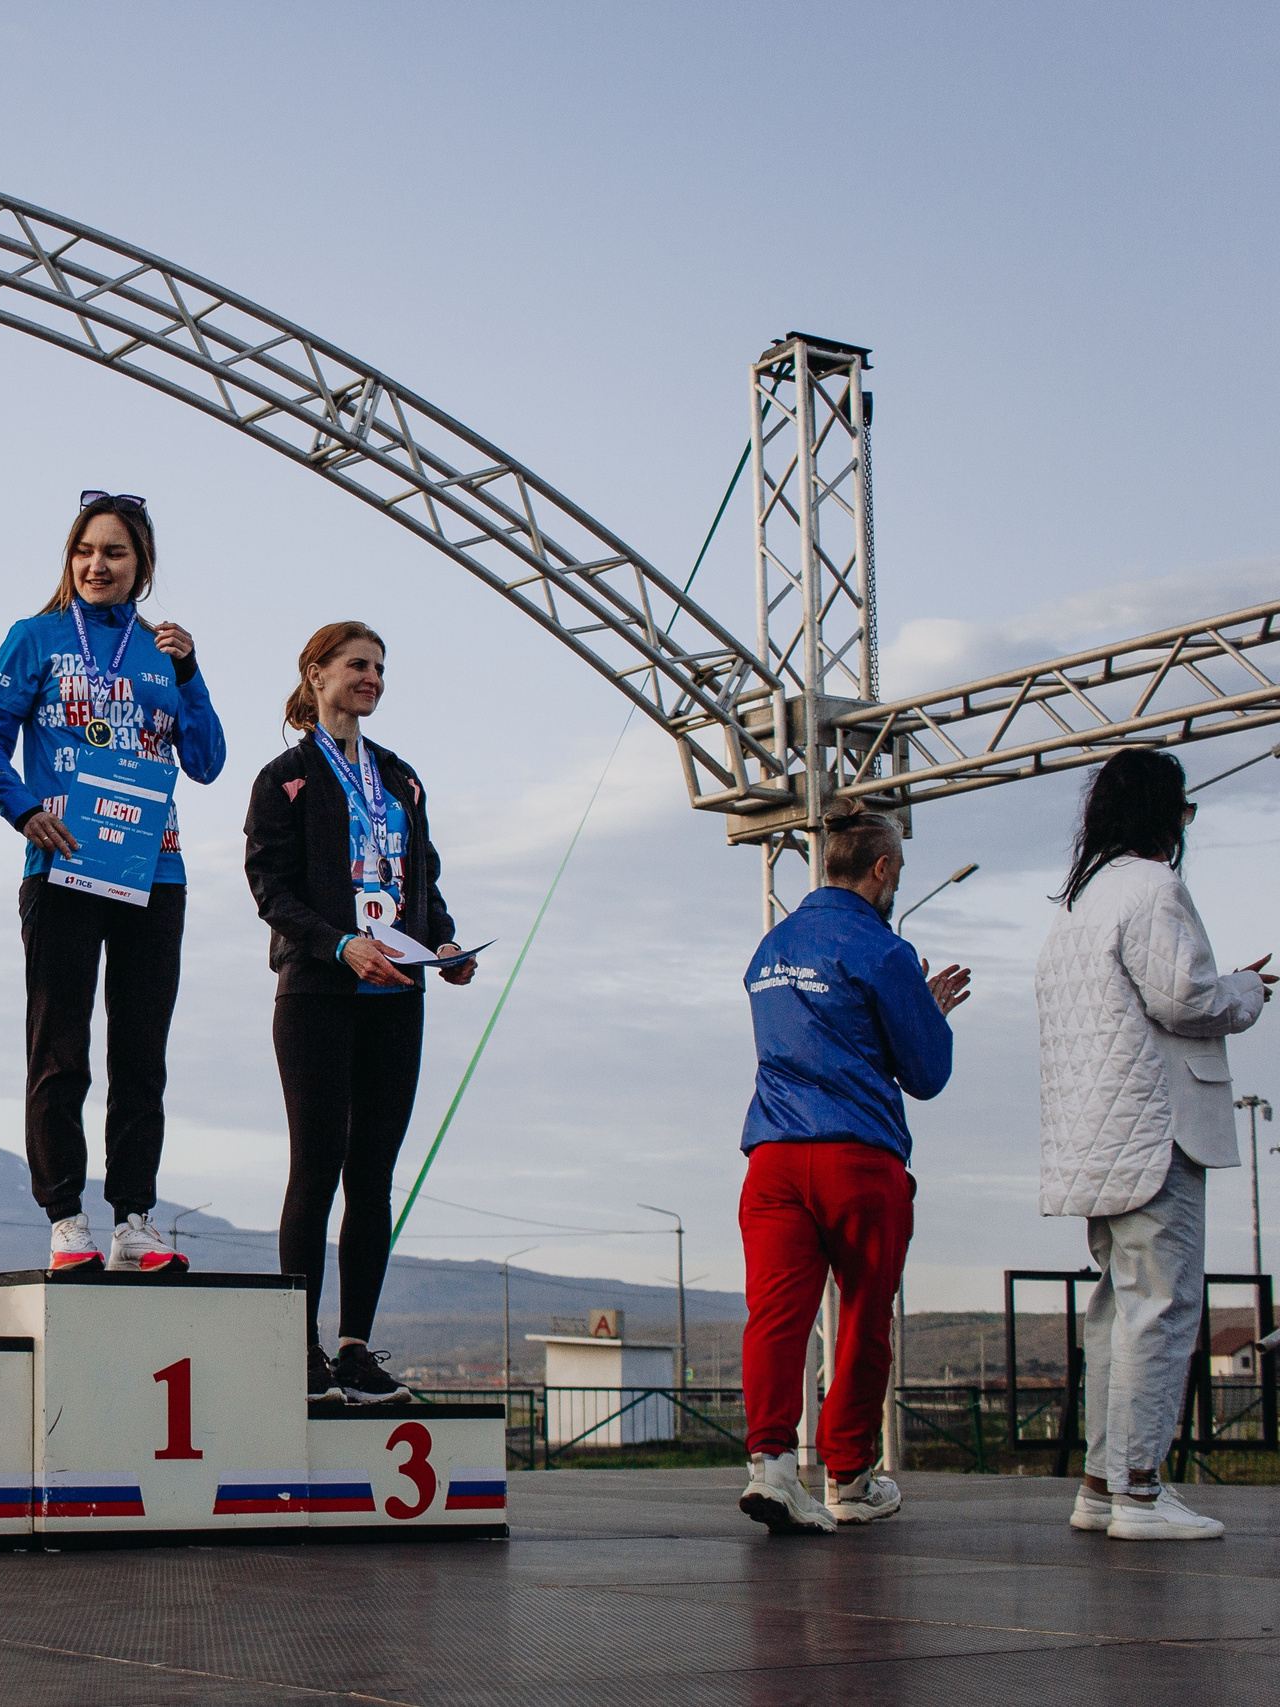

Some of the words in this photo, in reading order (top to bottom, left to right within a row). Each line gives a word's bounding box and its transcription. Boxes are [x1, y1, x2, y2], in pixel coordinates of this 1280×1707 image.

[50, 653, 100, 678] 202
[60, 676, 134, 702] #МТА
[100, 798, 142, 824] МЕСТО
[98, 826, 108, 840] 10
[109, 829, 125, 844] КМ
[76, 878, 92, 888] ПСБ
[108, 887, 131, 897] FONBET
[153, 1358, 203, 1460] 1
[385, 1422, 436, 1520] 3
